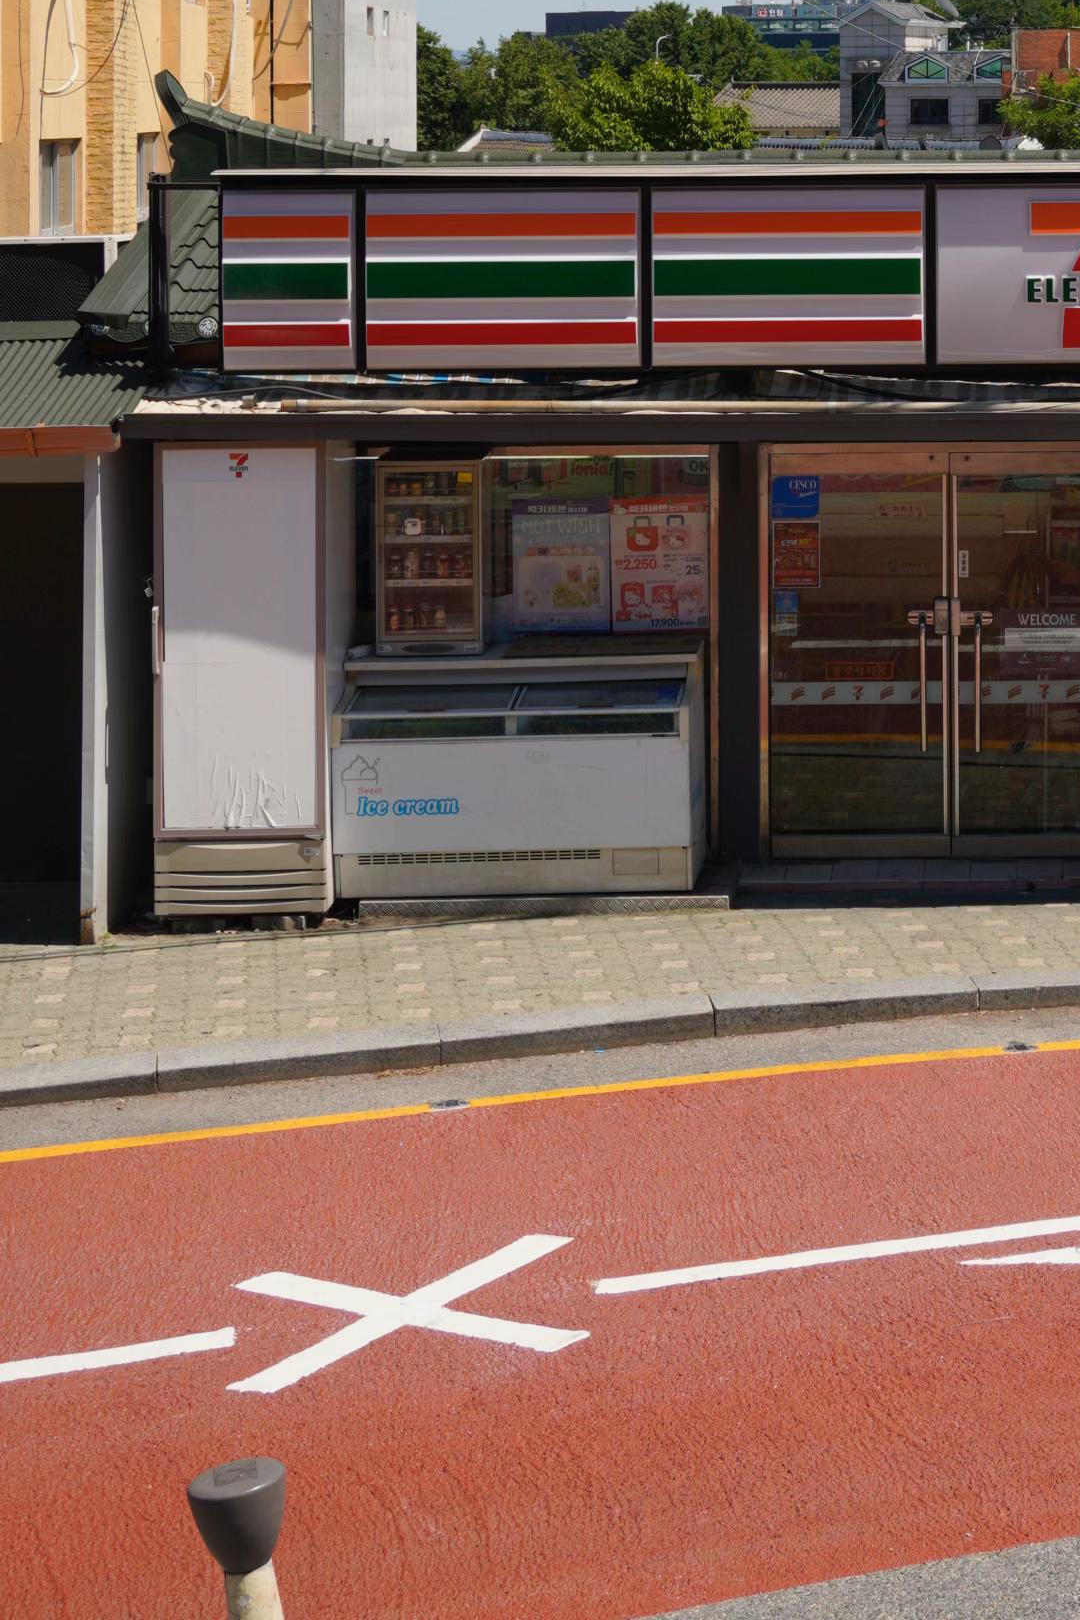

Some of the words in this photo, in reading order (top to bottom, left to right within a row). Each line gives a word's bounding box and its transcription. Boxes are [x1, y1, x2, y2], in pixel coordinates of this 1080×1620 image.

[1017, 612, 1077, 626] WELCOME
[357, 786, 383, 795] Sweet
[356, 795, 390, 817] Ice
[392, 797, 460, 817] cream
